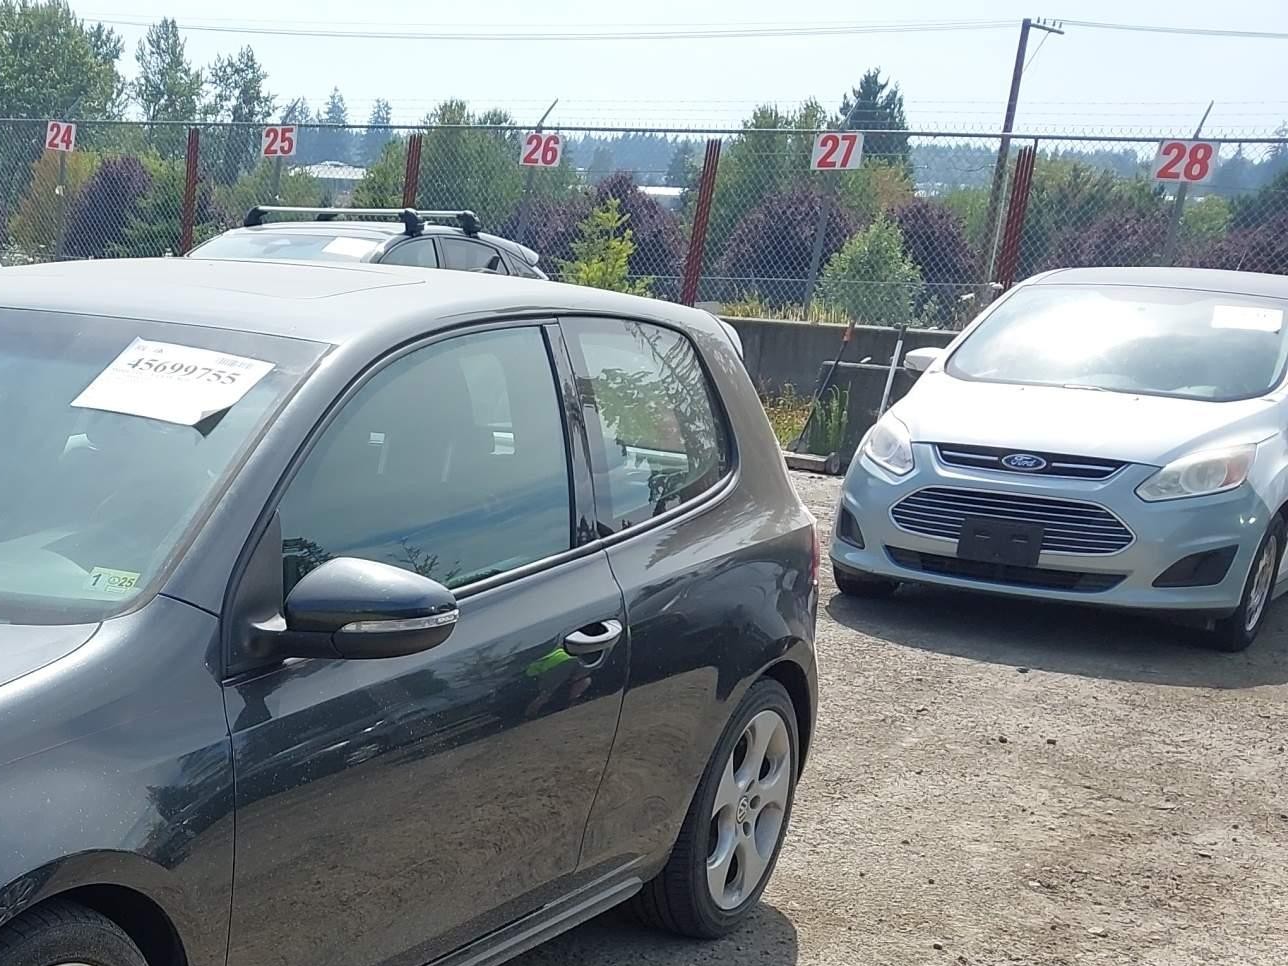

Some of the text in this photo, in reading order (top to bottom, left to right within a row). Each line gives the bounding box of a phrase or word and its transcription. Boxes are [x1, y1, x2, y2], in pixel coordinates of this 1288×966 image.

[48, 123, 73, 149] 24
[264, 128, 294, 155] 25
[523, 135, 560, 164] 26
[817, 135, 857, 168] 27
[1156, 143, 1212, 180] 28
[127, 357, 241, 385] 45699755
[92, 573, 135, 587] 1 25
